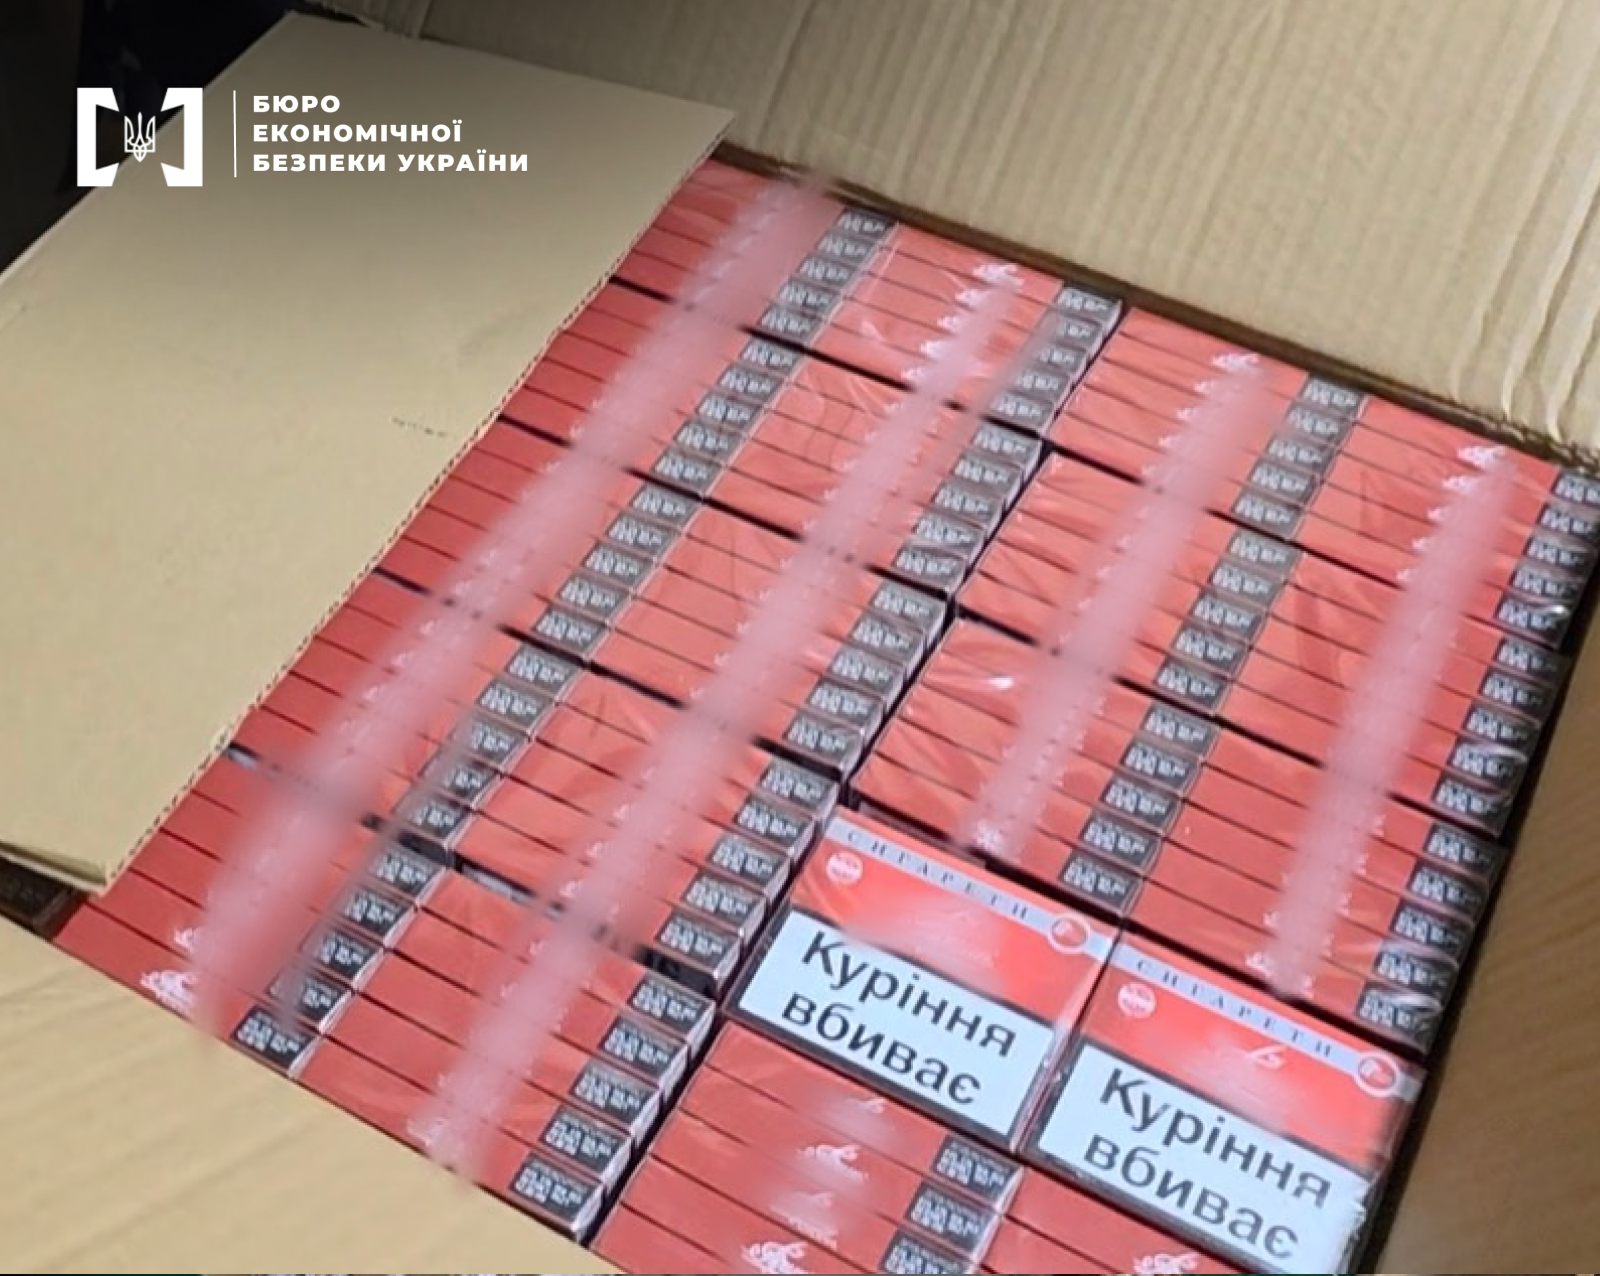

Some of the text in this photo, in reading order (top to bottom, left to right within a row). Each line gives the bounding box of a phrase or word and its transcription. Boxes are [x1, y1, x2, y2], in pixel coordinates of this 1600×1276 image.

[781, 992, 982, 1106] вбиває
[801, 930, 1017, 1058] Куріння
[1083, 1133, 1299, 1260] вбиває
[1099, 1067, 1332, 1209] Куріння
